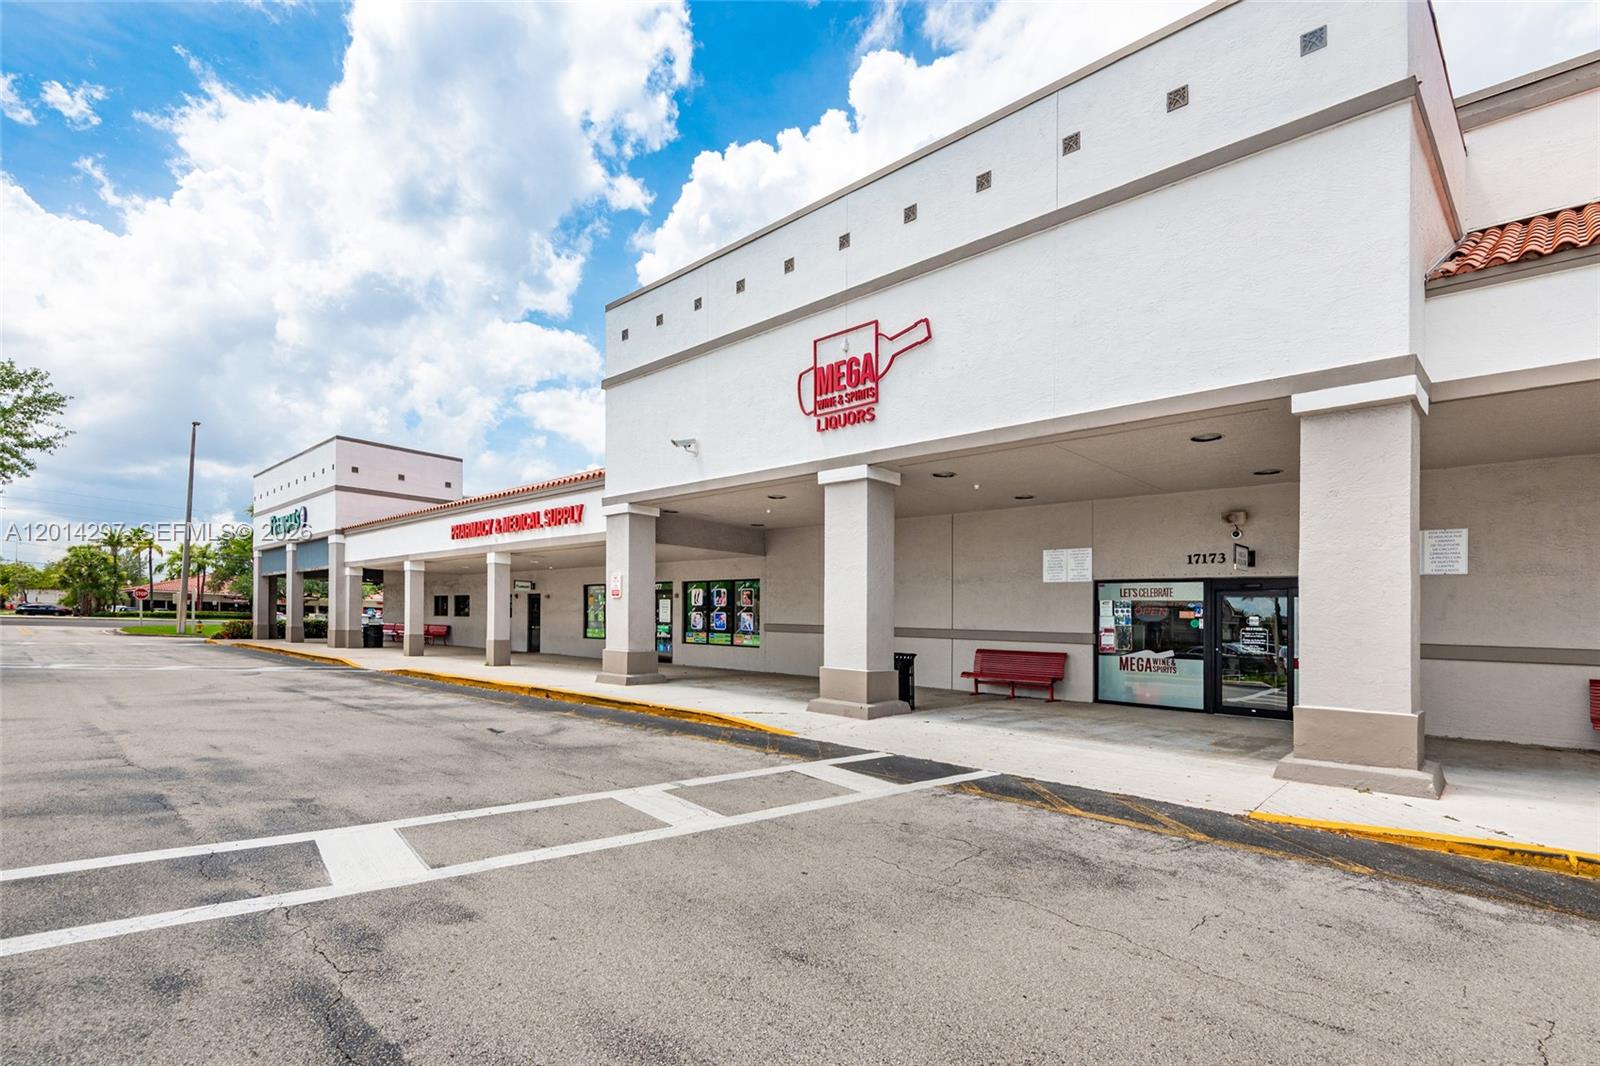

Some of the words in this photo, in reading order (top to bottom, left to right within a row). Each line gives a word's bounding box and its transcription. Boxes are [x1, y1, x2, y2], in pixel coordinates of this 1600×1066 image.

[816, 352, 876, 397] MEGA
[816, 395, 837, 411] WINE
[837, 394, 844, 406] &
[844, 386, 876, 404] SPIRITS
[816, 407, 876, 433] LIQUORS
[451, 519, 494, 540] PHARMACY
[495, 519, 502, 534] &
[501, 511, 544, 533] MEDICAL
[544, 504, 584, 528] SUPPLY
[1187, 552, 1226, 565] 17173
[1120, 588, 1138, 598] LET'S
[1138, 587, 1174, 598] CELEBRATE
[1119, 656, 1152, 673] MEGA
[1152, 657, 1170, 666] WINE
[1170, 658, 1176, 666] &
[1152, 665, 1177, 674] SPIRITS
